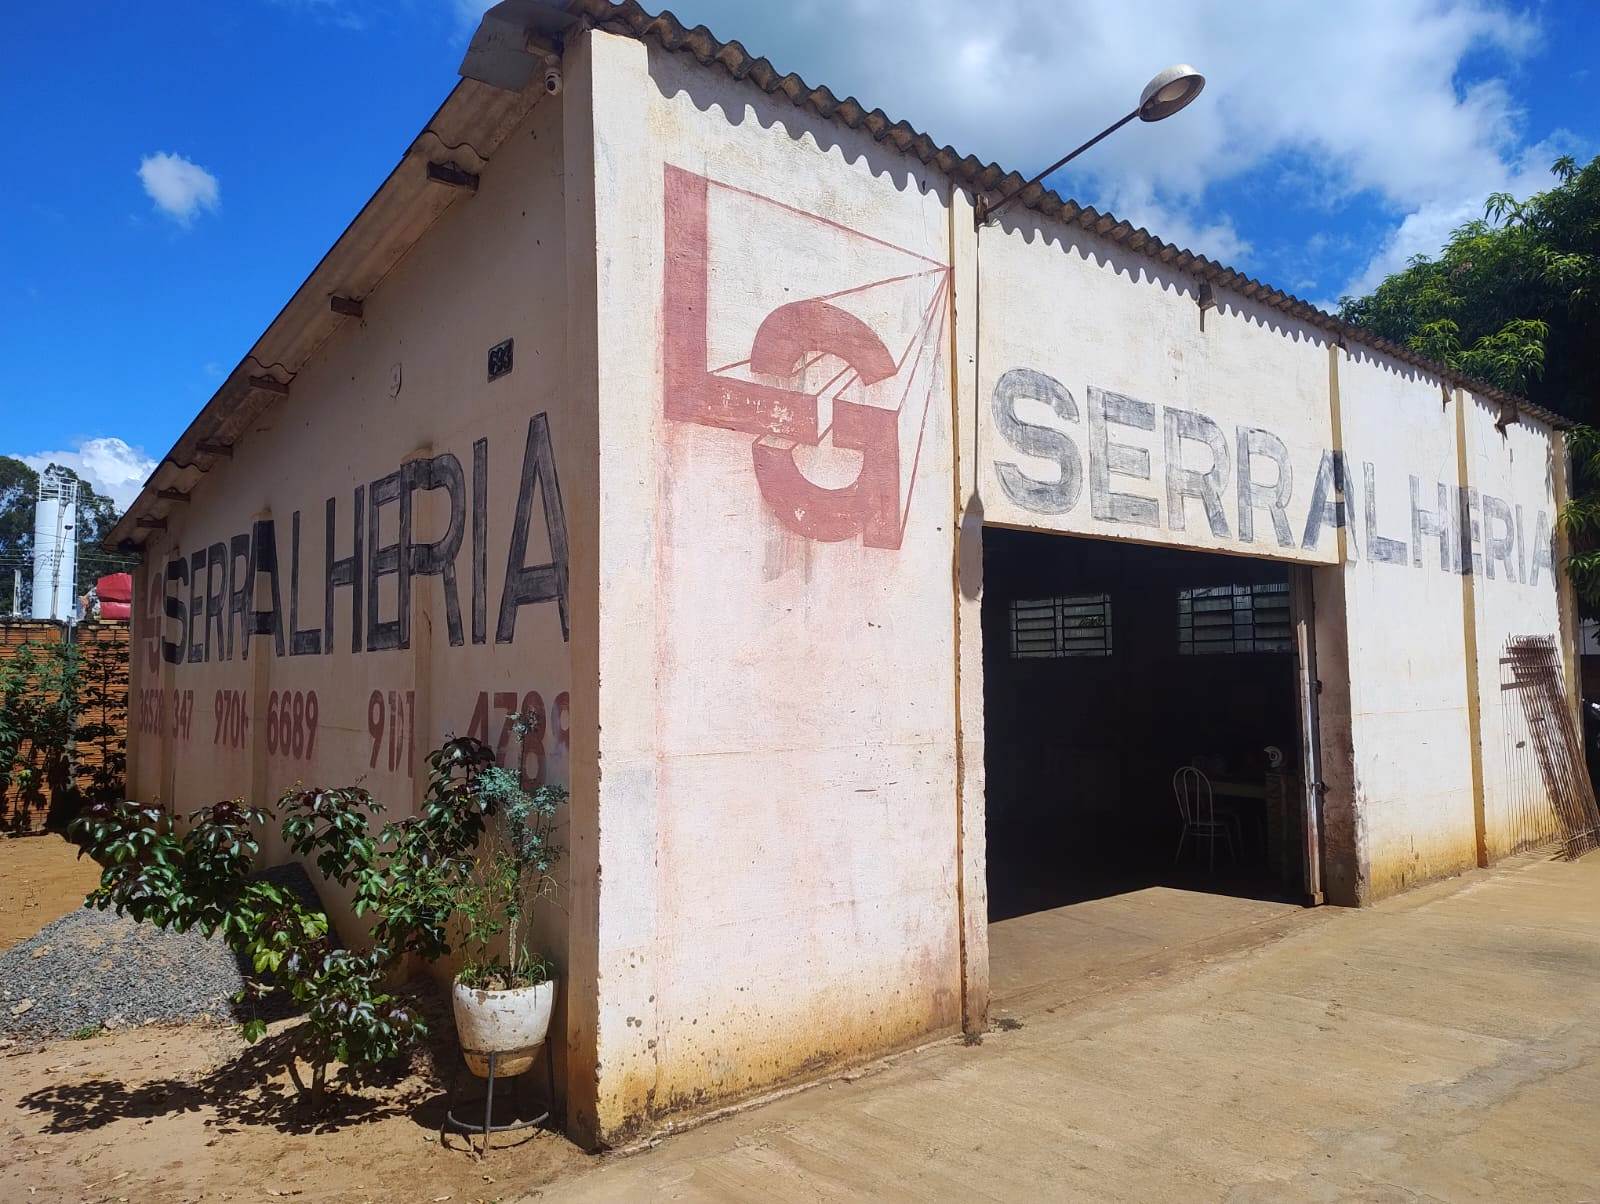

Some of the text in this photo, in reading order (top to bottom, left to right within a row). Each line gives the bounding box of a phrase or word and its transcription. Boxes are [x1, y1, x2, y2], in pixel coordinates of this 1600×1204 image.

[161, 411, 569, 665] SERRALHERIA
[992, 367, 1558, 588] SERRALHERIA
[266, 690, 319, 761] 6689
